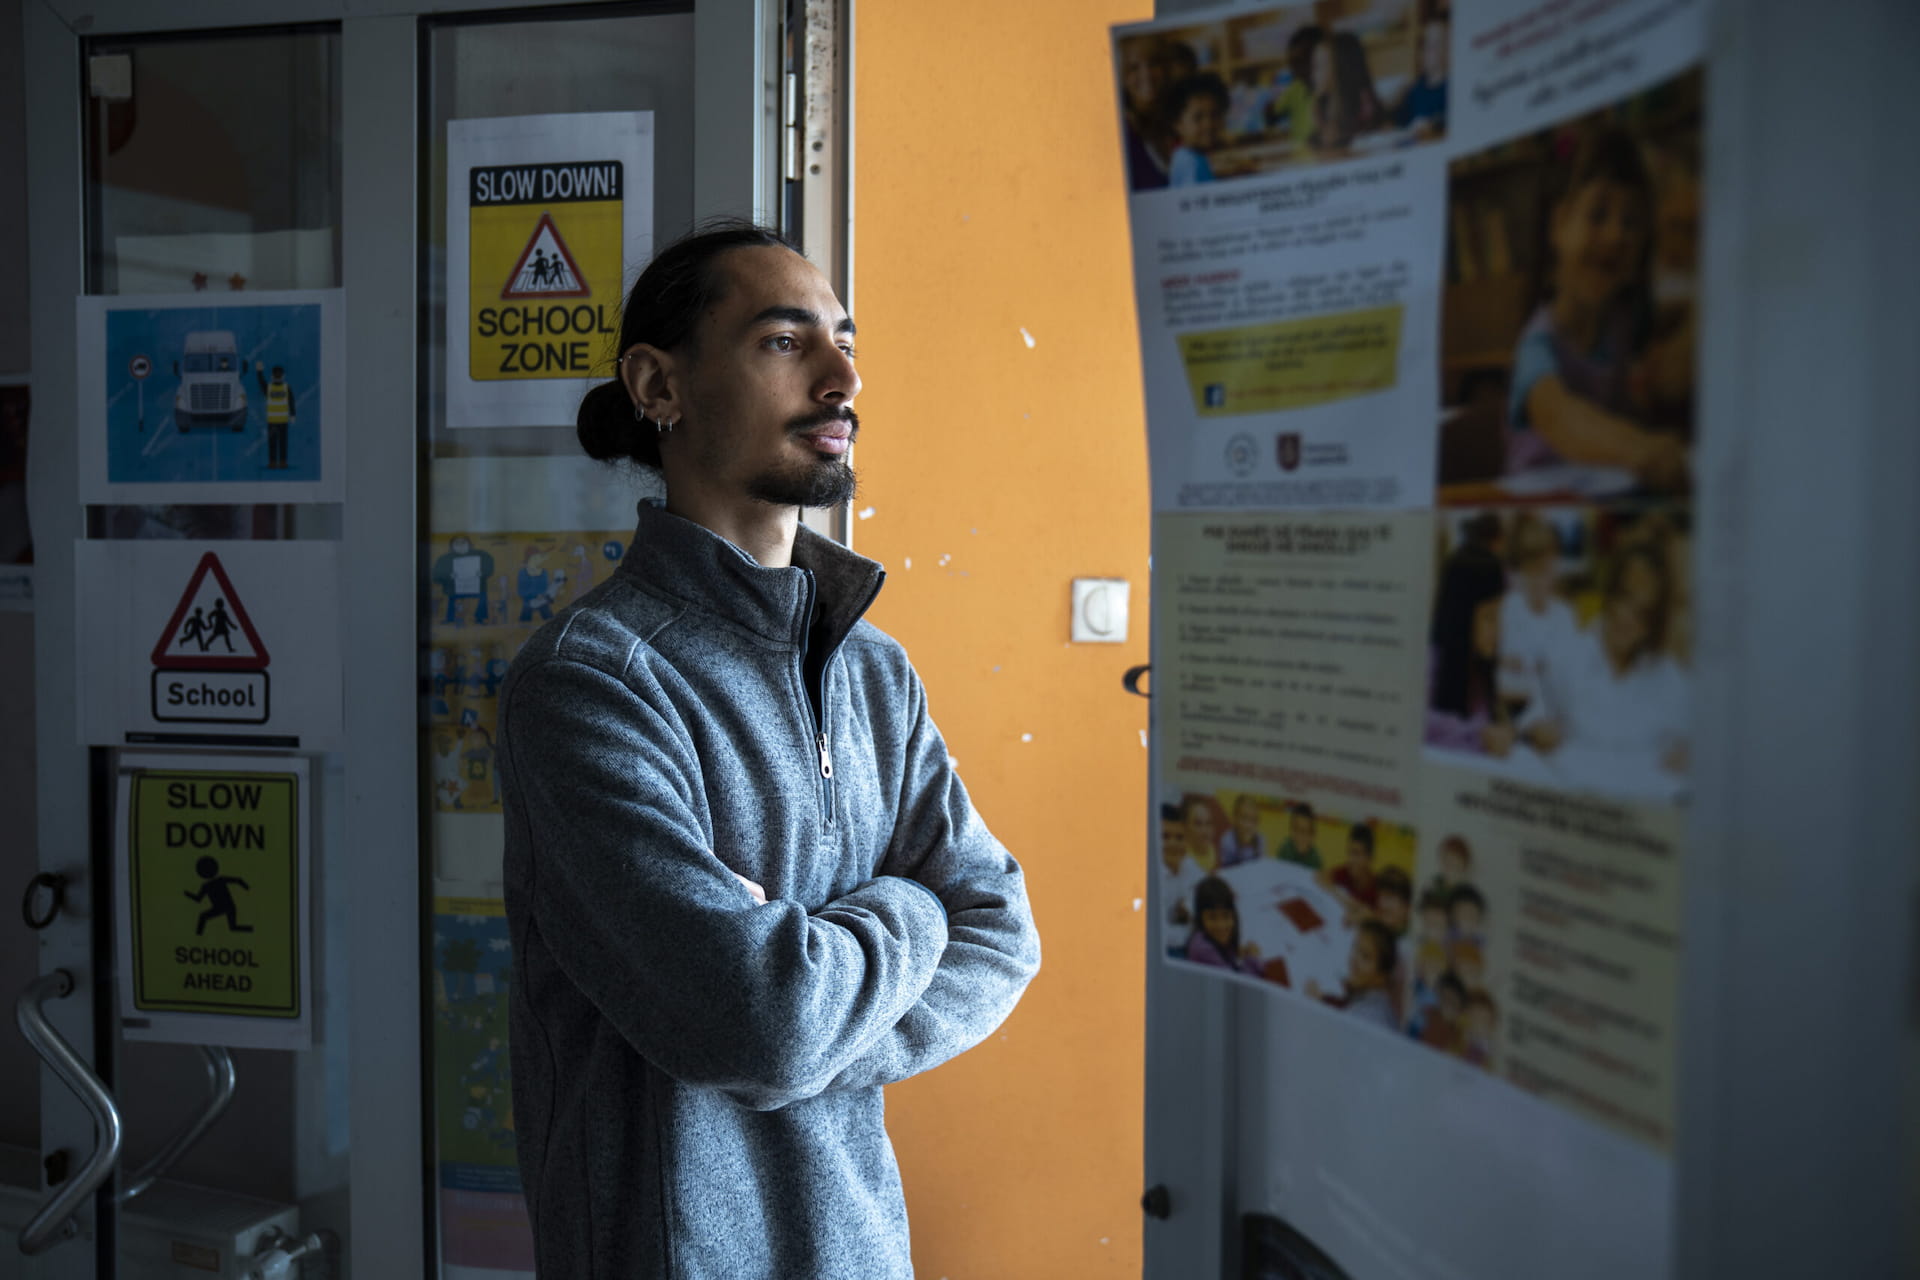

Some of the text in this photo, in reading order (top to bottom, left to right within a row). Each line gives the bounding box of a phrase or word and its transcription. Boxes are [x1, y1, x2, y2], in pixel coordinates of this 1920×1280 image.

[476, 166, 616, 201] SLOW DOWN!
[478, 304, 615, 337] SCHOOL
[499, 342, 590, 373] ZONE
[167, 682, 256, 707] School
[167, 783, 262, 810] SLOW
[165, 822, 265, 850] DOWN
[175, 946, 260, 968] SCHOOL
[183, 972, 253, 992] AHEAD
